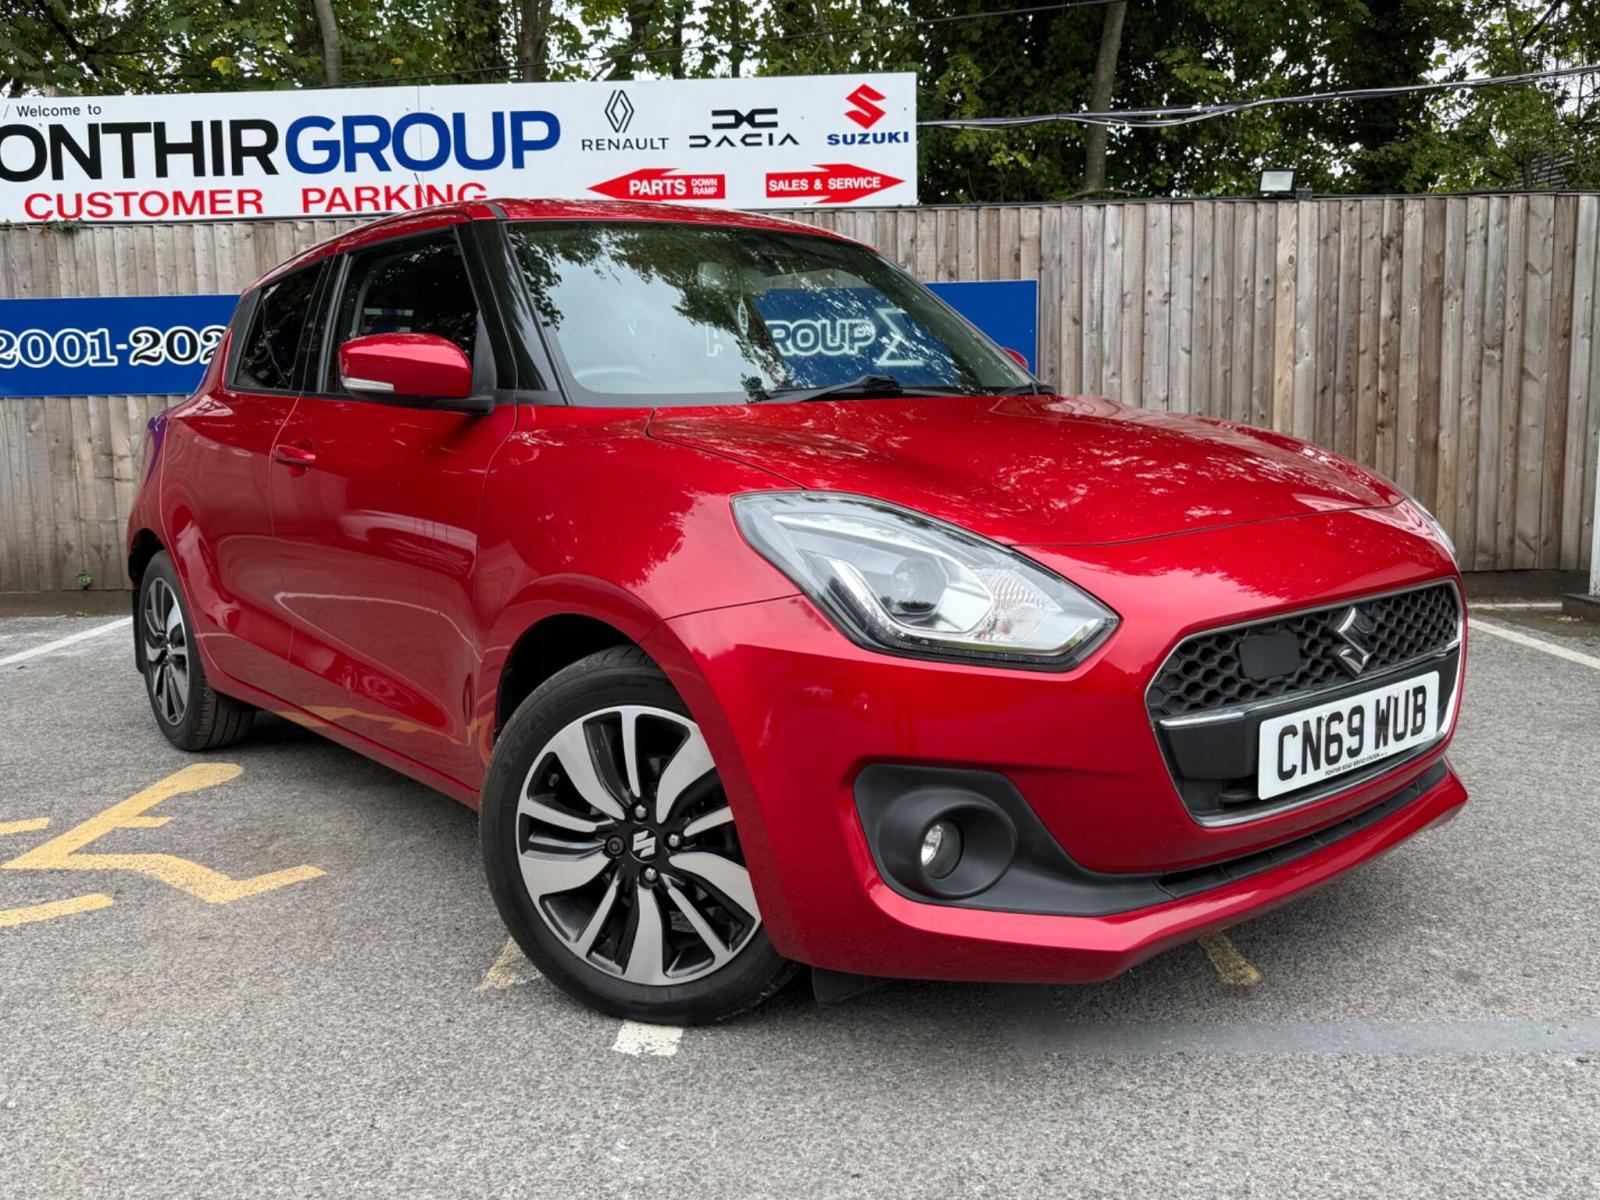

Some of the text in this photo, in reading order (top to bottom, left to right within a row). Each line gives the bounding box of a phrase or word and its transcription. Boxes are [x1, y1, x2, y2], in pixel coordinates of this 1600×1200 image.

[16, 103, 102, 118] Welcome to
[581, 137, 669, 151] RENAULT
[689, 133, 800, 148] DACIA
[827, 131, 909, 146] SUZUKI
[629, 178, 687, 196] PARTS
[691, 178, 718, 187] DOWN
[768, 175, 881, 192] SALES & SERVICE
[692, 186, 718, 195] RAMP
[24, 182, 488, 220] CUSTOMER PARKING
[1277, 685, 1428, 781] CN69 WUB
